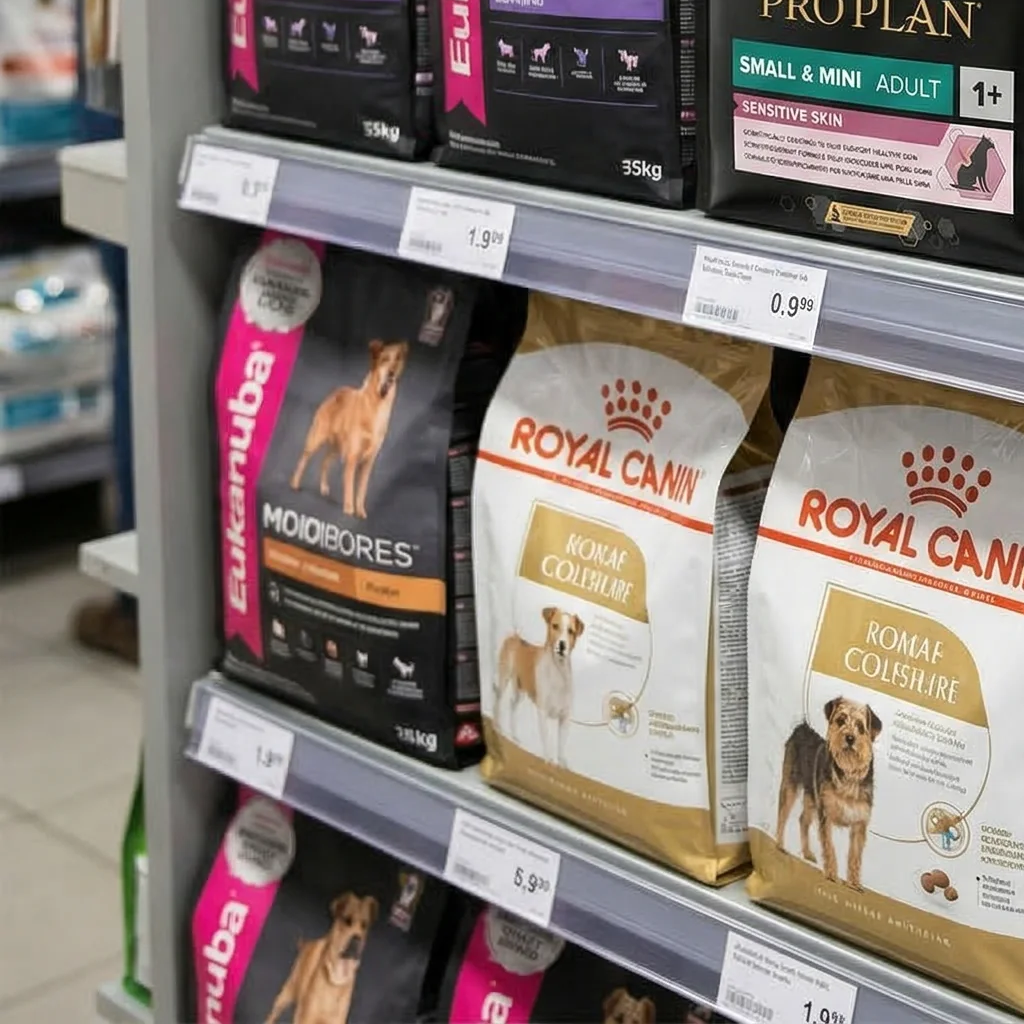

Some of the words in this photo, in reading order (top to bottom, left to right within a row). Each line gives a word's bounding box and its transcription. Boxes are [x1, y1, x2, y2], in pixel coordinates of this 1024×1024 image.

[739, 55, 796, 80] SMALL
[801, 64, 814, 83] &
[819, 66, 861, 89] MINI
[876, 74, 941, 99] ADULT
[971, 81, 1002, 107] 1+
[742, 100, 808, 123] SENSITIVE
[811, 109, 843, 127] SKIN
[511, 417, 612, 479] ROYAL
[621, 449, 700, 505] CANIN
[799, 489, 918, 558] ROYAL
